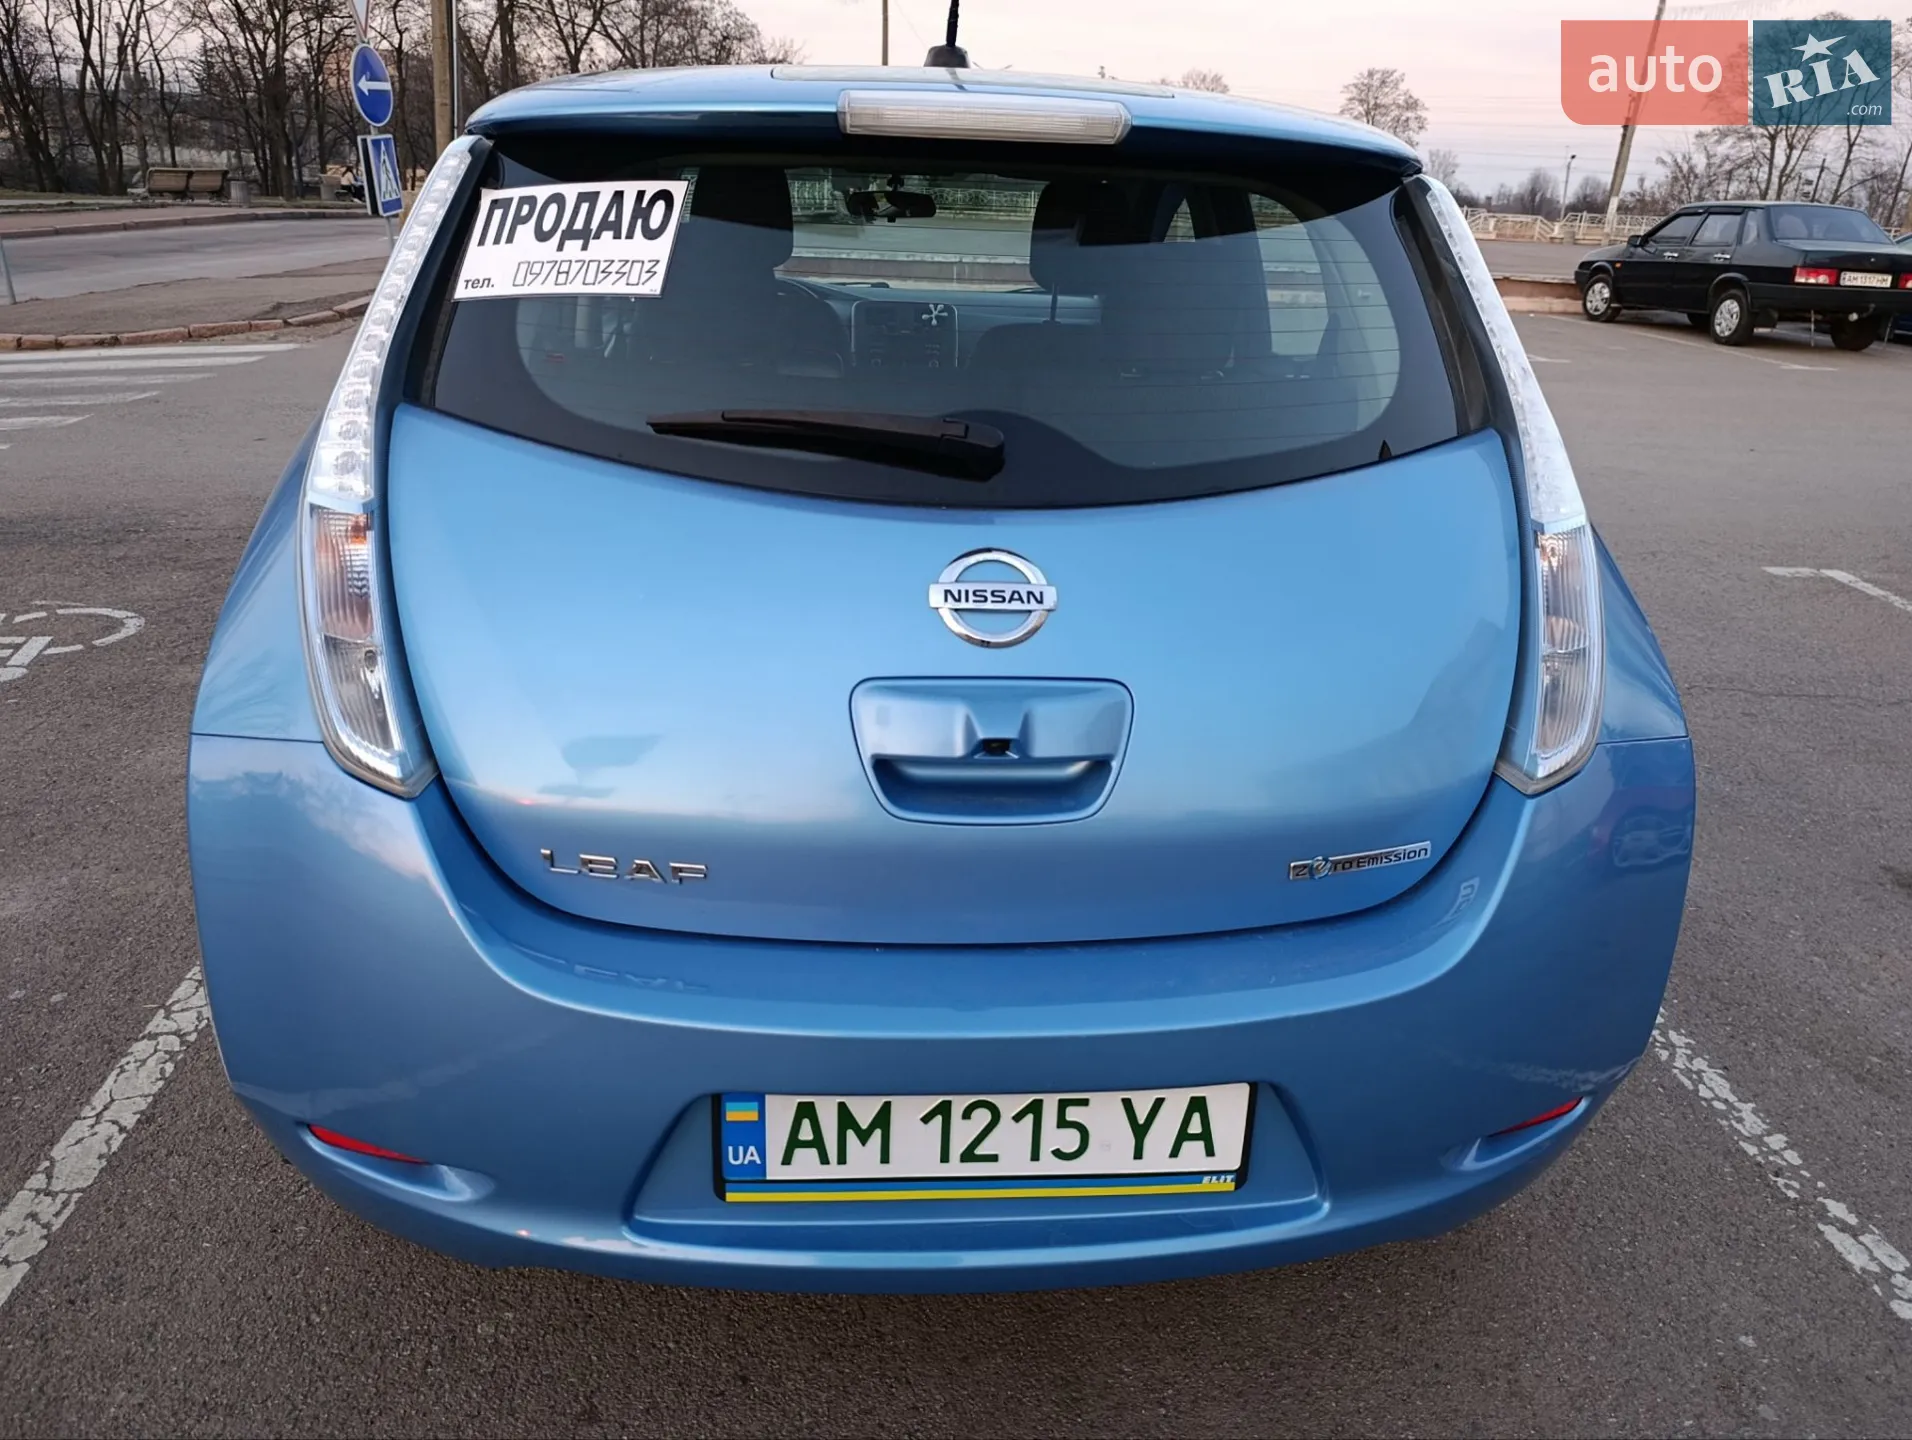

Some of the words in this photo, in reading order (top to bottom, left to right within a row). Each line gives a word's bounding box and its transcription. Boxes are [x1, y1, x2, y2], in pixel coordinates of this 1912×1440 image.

[477, 188, 675, 252] ПРОДАЮ
[463, 277, 495, 290] тел.
[512, 259, 660, 287] 0978703303
[944, 589, 1044, 604] NISSAN
[540, 848, 708, 884] LEAF
[1356, 847, 1428, 868] Emission
[781, 1100, 892, 1165] AM
[919, 1097, 1090, 1164] 1215
[1120, 1095, 1216, 1160] YA
[728, 1145, 761, 1165] UA
